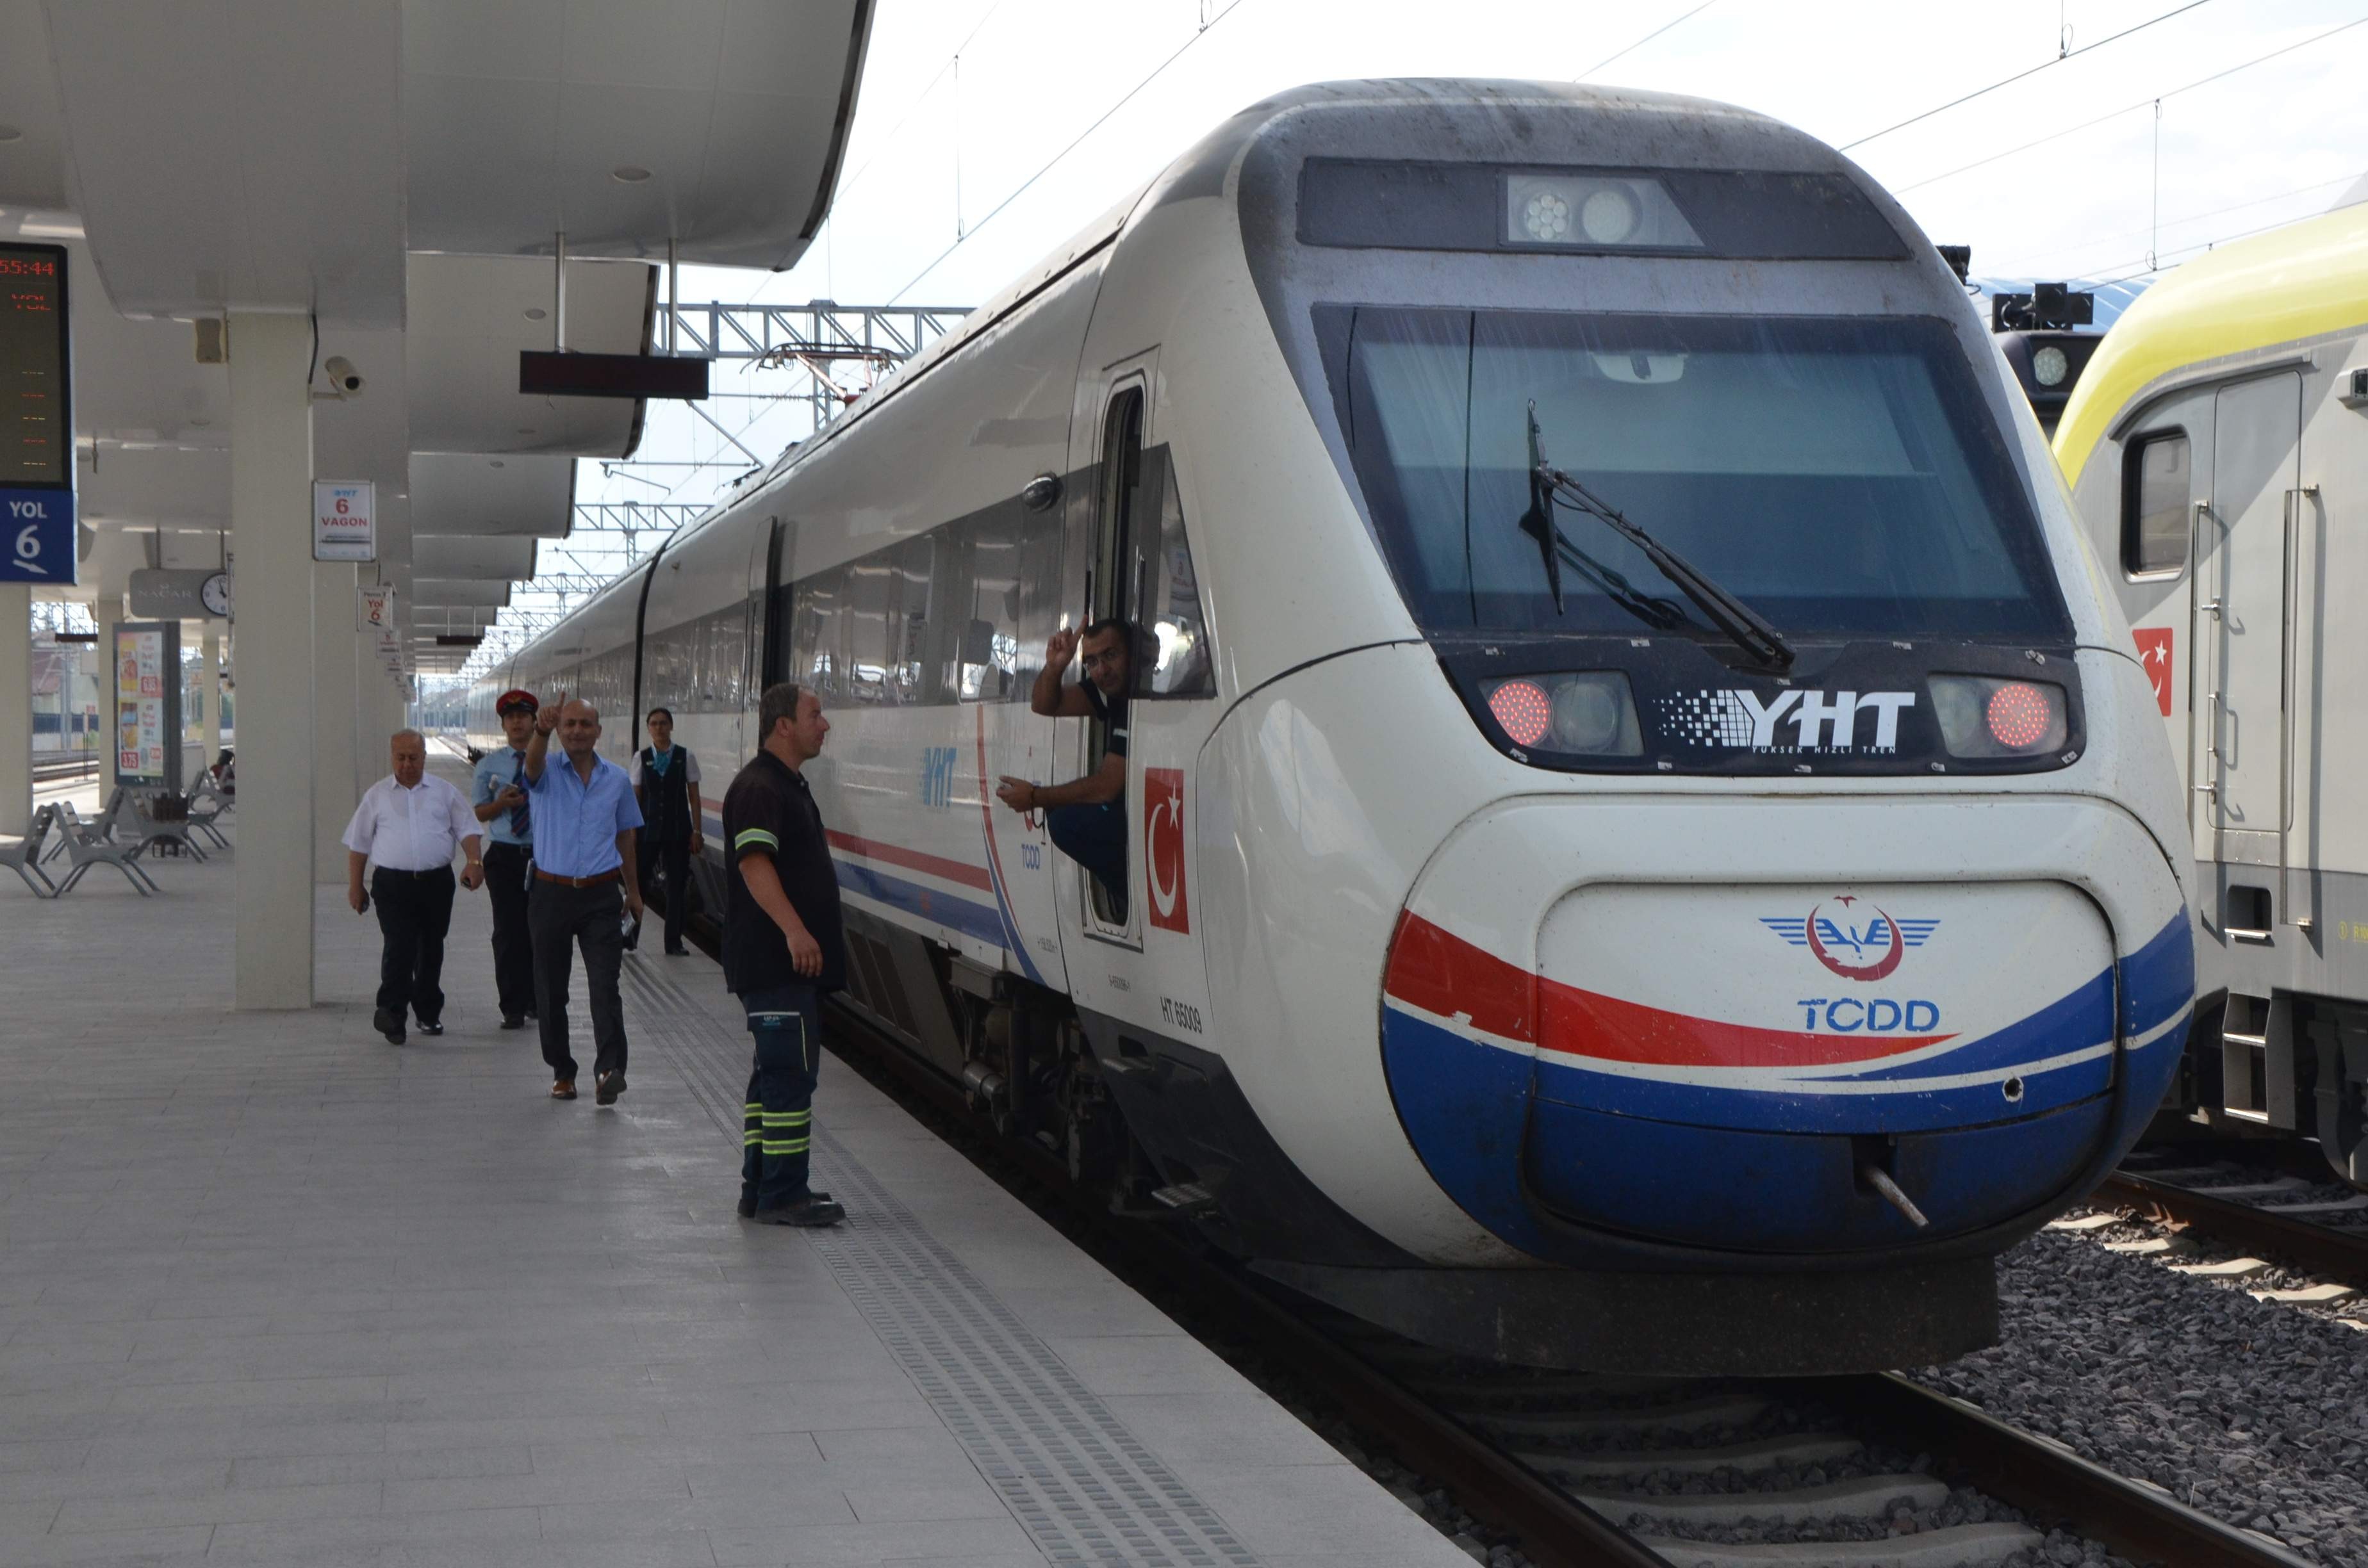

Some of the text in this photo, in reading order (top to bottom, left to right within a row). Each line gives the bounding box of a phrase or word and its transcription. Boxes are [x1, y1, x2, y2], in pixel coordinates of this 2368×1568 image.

[10, 502, 48, 518] YOL
[336, 498, 349, 514] 6
[322, 517, 368, 527] VAGON
[16, 525, 41, 559] 6
[368, 599, 384, 608] Yol
[371, 608, 380, 620] 6
[1733, 689, 1916, 747] YHT
[924, 747, 957, 808] YHT
[1021, 843, 1041, 870] TCDD
[1160, 996, 1203, 1034] HT 65009
[1797, 997, 1940, 1032] TCDD
